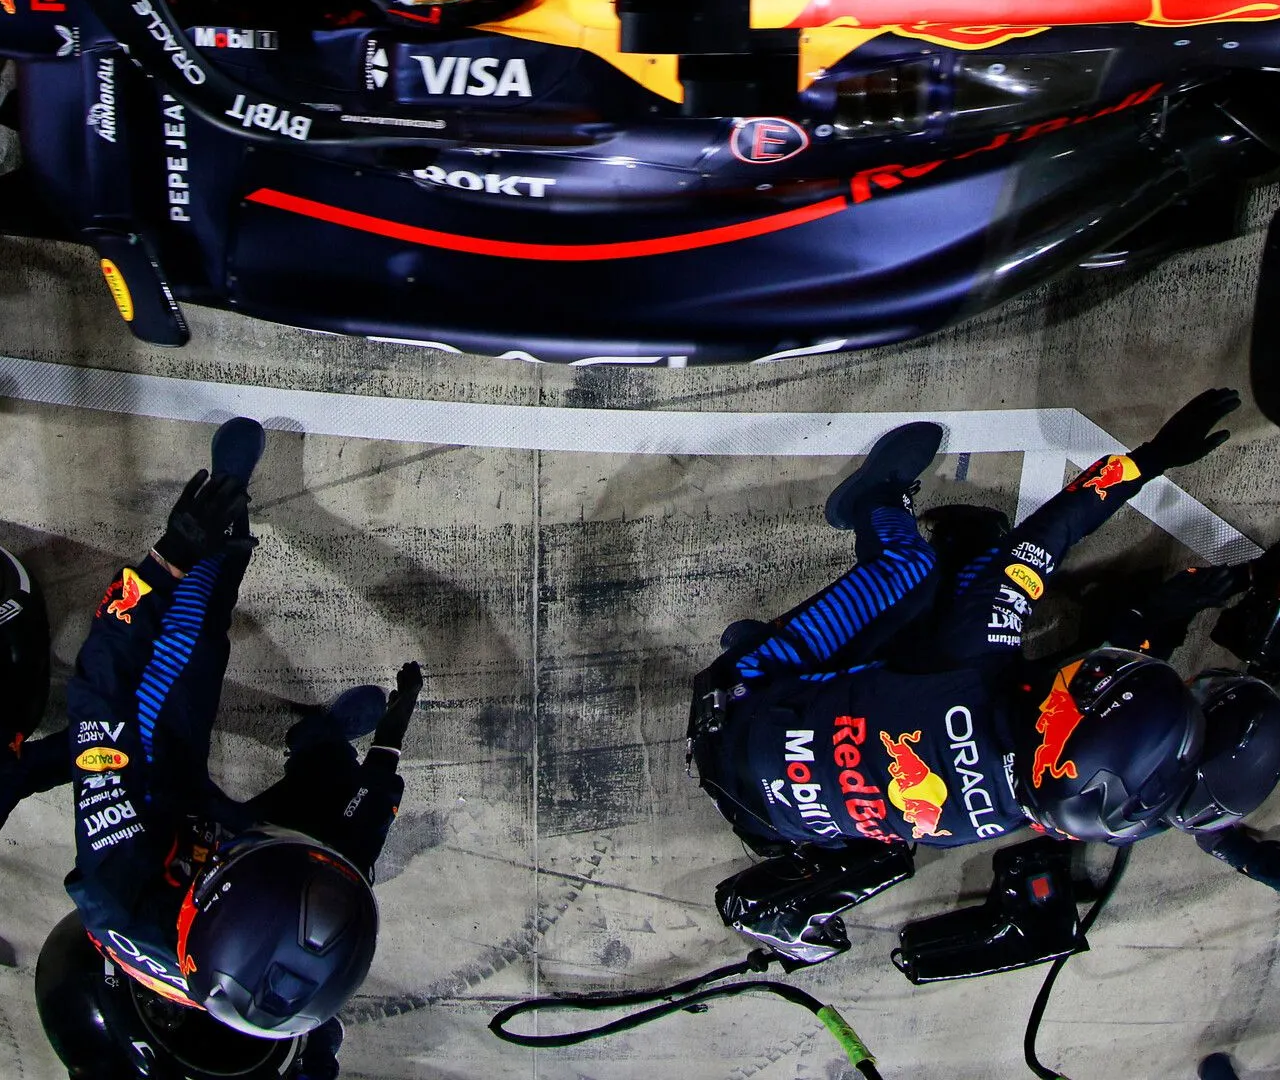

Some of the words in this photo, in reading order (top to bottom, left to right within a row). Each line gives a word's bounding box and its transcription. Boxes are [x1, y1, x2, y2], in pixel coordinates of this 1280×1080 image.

[194, 27, 255, 49] Mobil
[410, 56, 533, 97] VISA
[162, 94, 189, 149] JEA
[225, 94, 313, 141] BYBIT
[166, 156, 192, 222] PEPE
[412, 165, 557, 197] ROKT
[1011, 548, 1048, 569] ARCTIC
[1018, 540, 1043, 558] WOLF
[1011, 567, 1038, 591] RAUCH
[77, 731, 105, 744] ARCTIC
[82, 754, 114, 765] RAUCH
[945, 705, 1005, 840] ORACLE
[785, 729, 831, 824] Mobil
[83, 800, 138, 837] ROKT
[343, 787, 369, 818] sparco
[91, 822, 147, 851] infinitum
[108, 929, 189, 991] ORA
